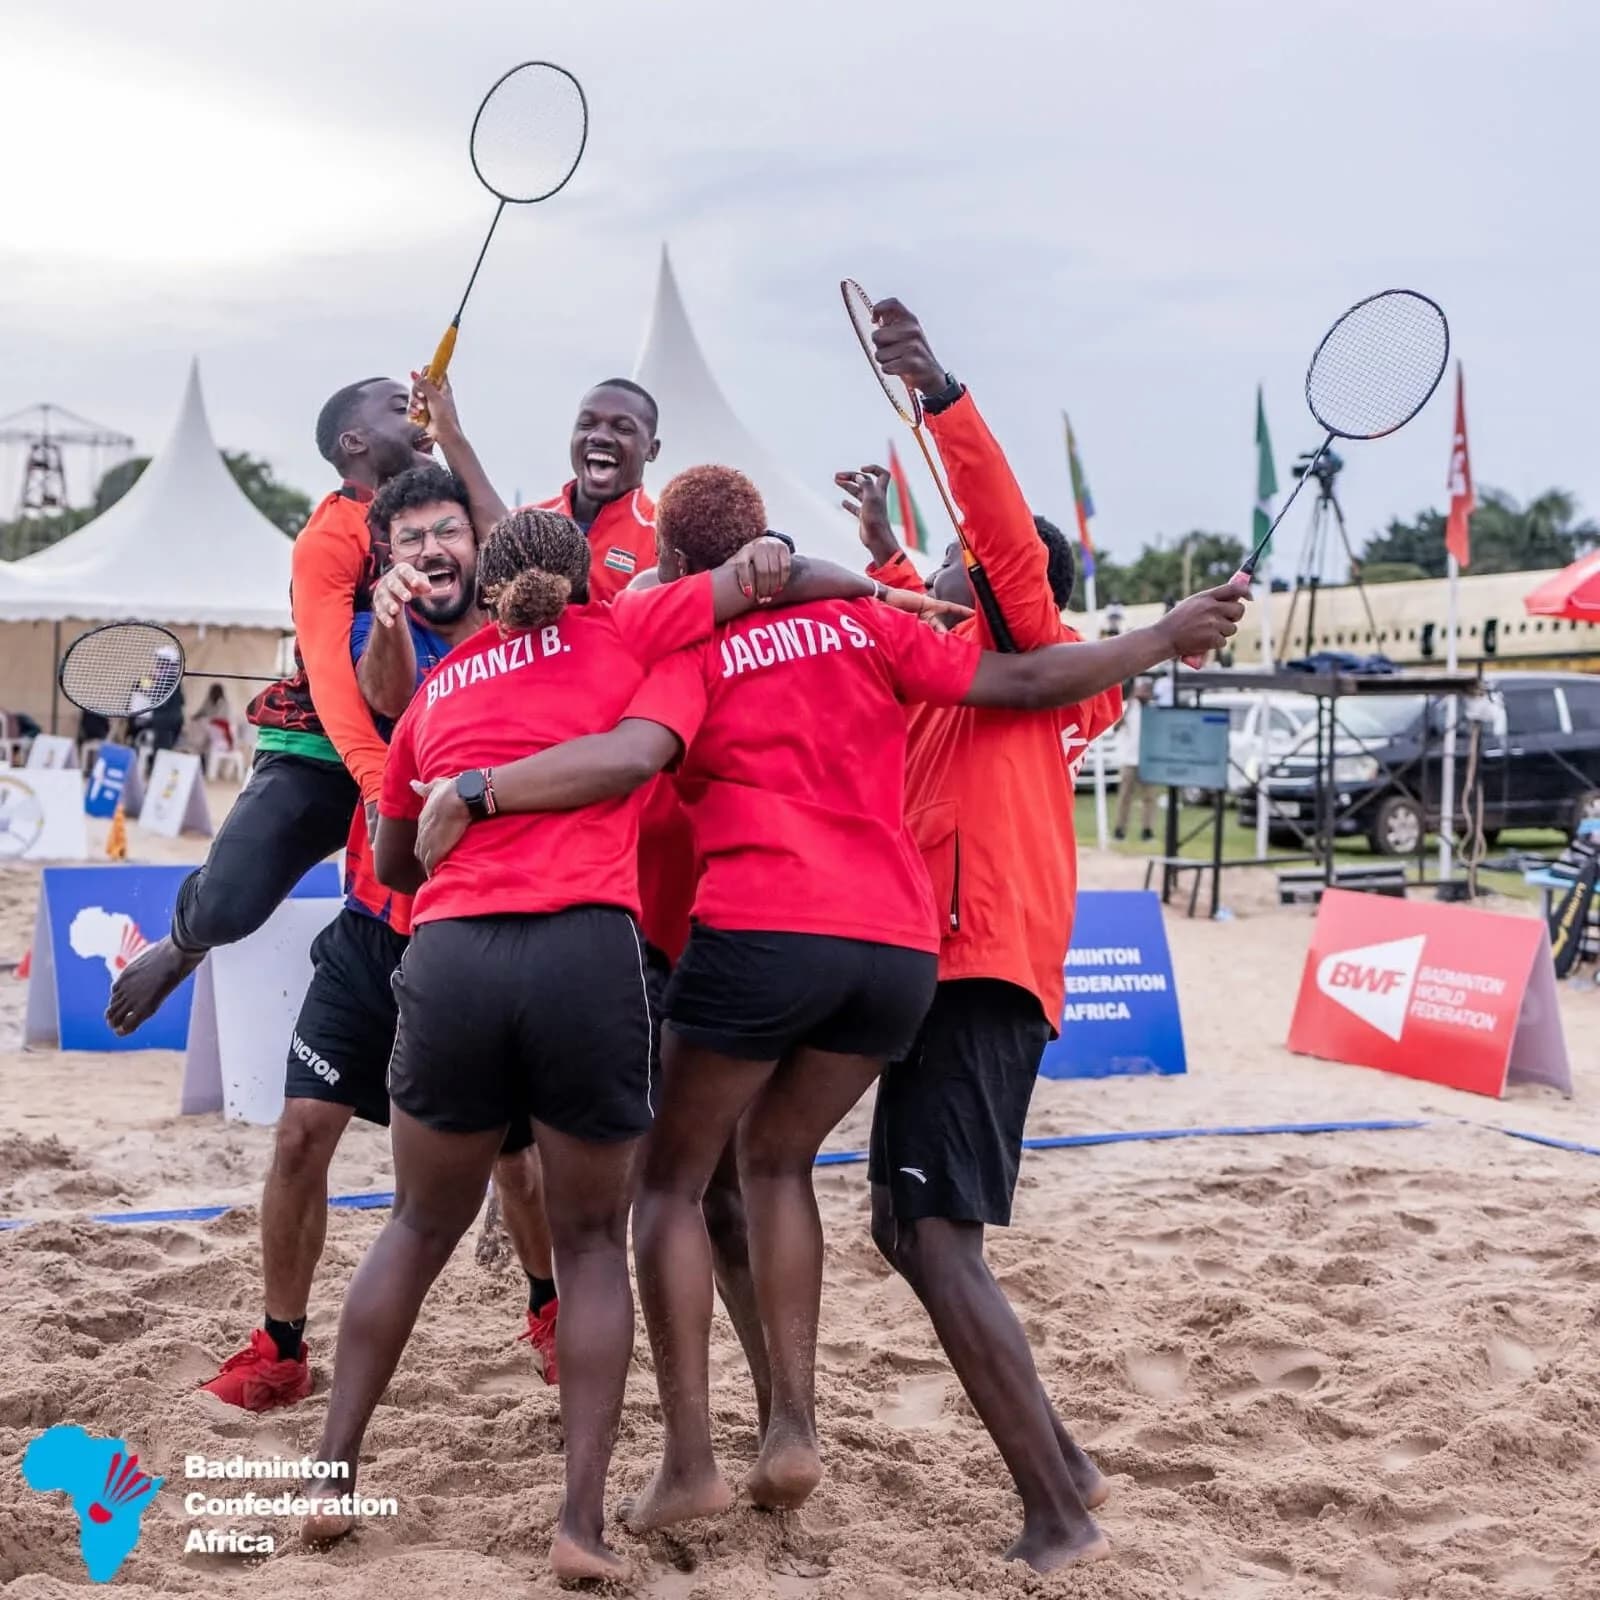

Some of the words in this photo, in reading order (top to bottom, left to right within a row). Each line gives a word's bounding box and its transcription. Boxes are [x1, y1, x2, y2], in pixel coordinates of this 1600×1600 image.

[720, 618, 843, 678] JACINTA
[839, 614, 876, 649] S.
[426, 633, 534, 710] BUYANZI
[541, 625, 571, 657] B.
[1064, 974, 1167, 993] EDERATION
[1329, 961, 1407, 995] BWF
[1416, 983, 1467, 1006] WORLD
[1418, 965, 1506, 996] BADMINTON
[1063, 1002, 1132, 1021] AFRICA
[1410, 1000, 1498, 1033] FEDERATION
[292, 1030, 341, 1087] VICTOR
